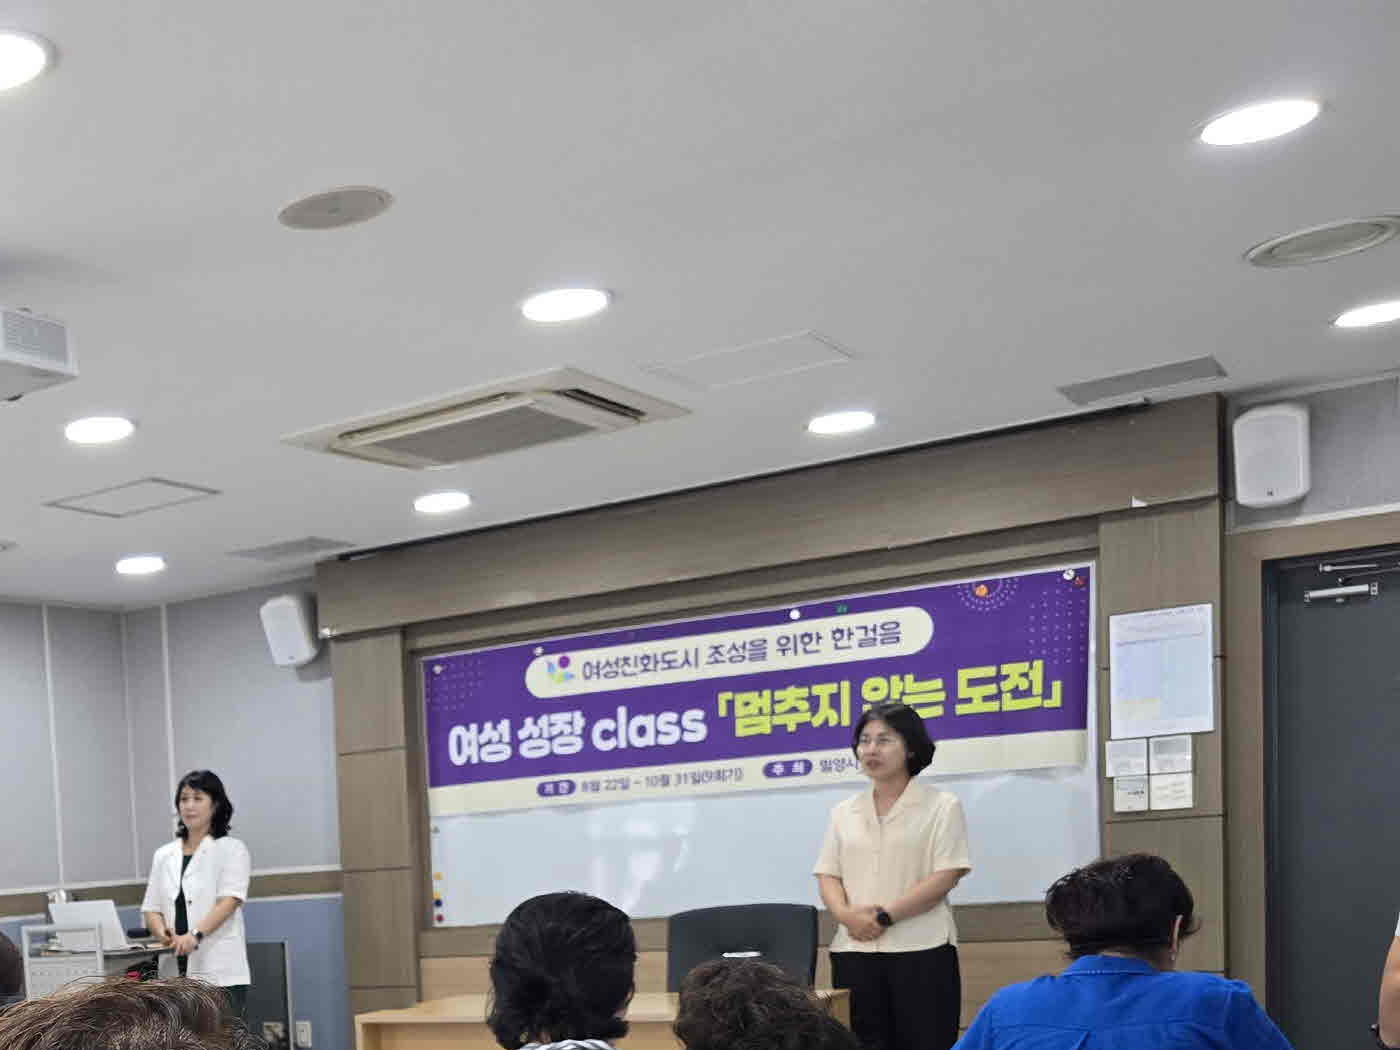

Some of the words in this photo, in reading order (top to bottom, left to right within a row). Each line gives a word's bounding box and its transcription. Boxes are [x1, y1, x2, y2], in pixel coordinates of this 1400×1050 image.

[582, 649, 700, 682] 여성친화도시
[705, 638, 769, 667] 조성을
[775, 630, 823, 658] 위한
[830, 620, 902, 651] 한걸음
[448, 718, 512, 766] 여성
[517, 710, 586, 759] 성장
[591, 705, 708, 752] class
